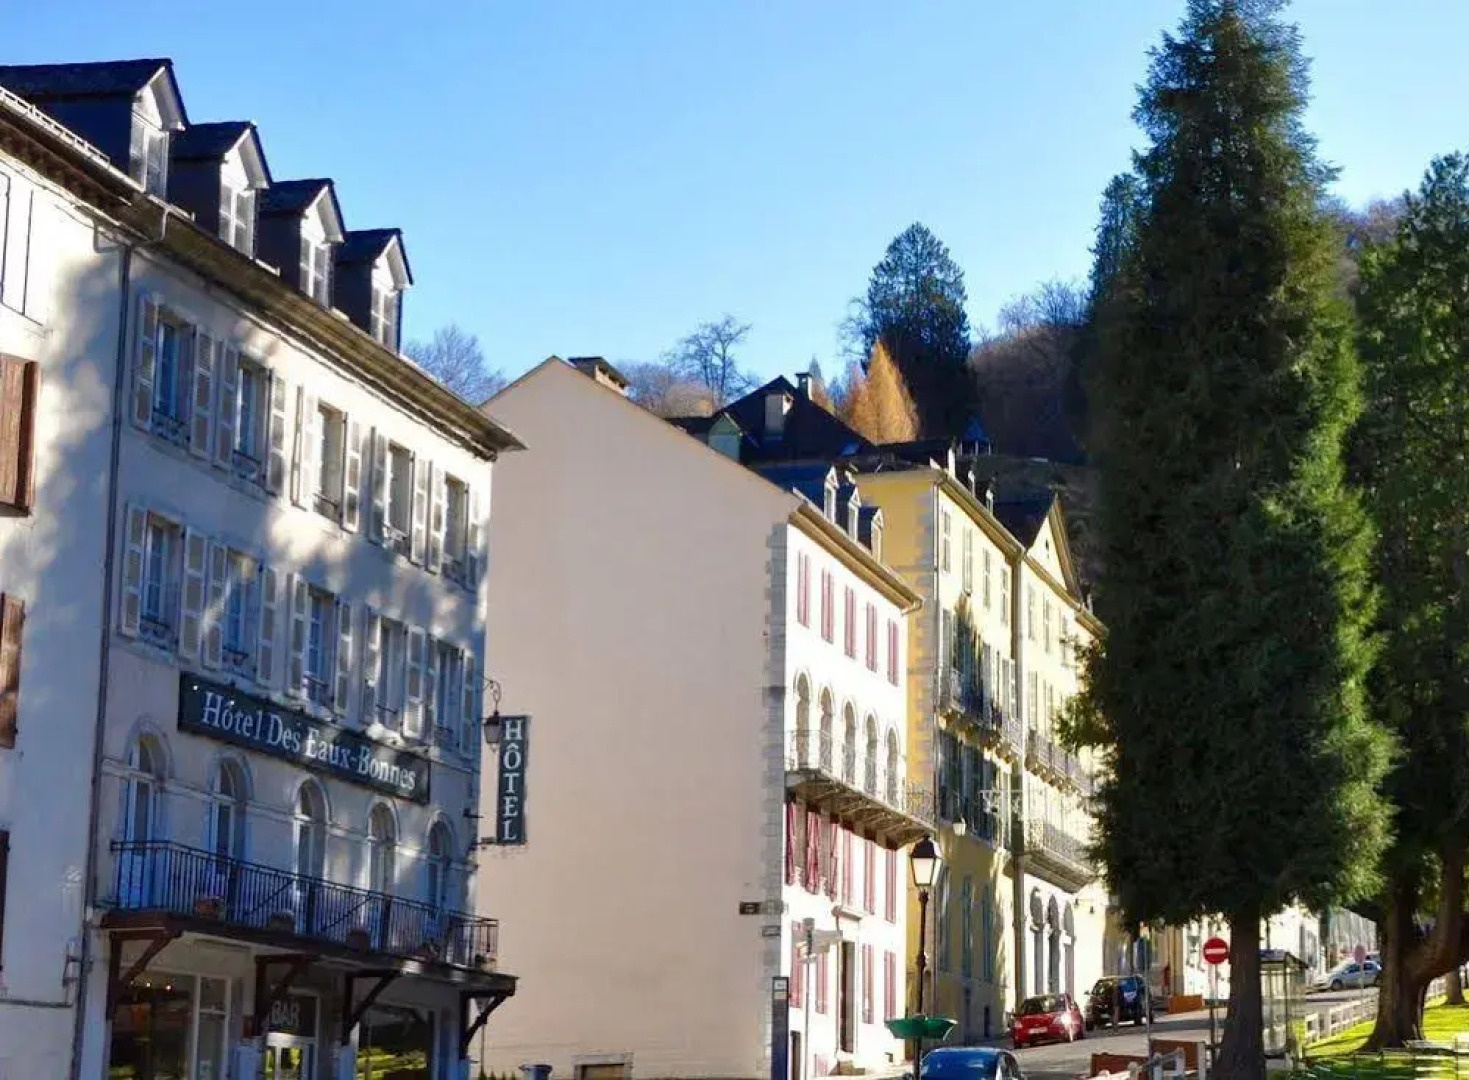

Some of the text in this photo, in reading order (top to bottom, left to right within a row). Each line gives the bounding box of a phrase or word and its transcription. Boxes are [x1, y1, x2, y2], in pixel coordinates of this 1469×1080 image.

[202, 691, 417, 791] Hôtel Des Eaux-Bonnes
[502, 720, 523, 840] HÔTEL
